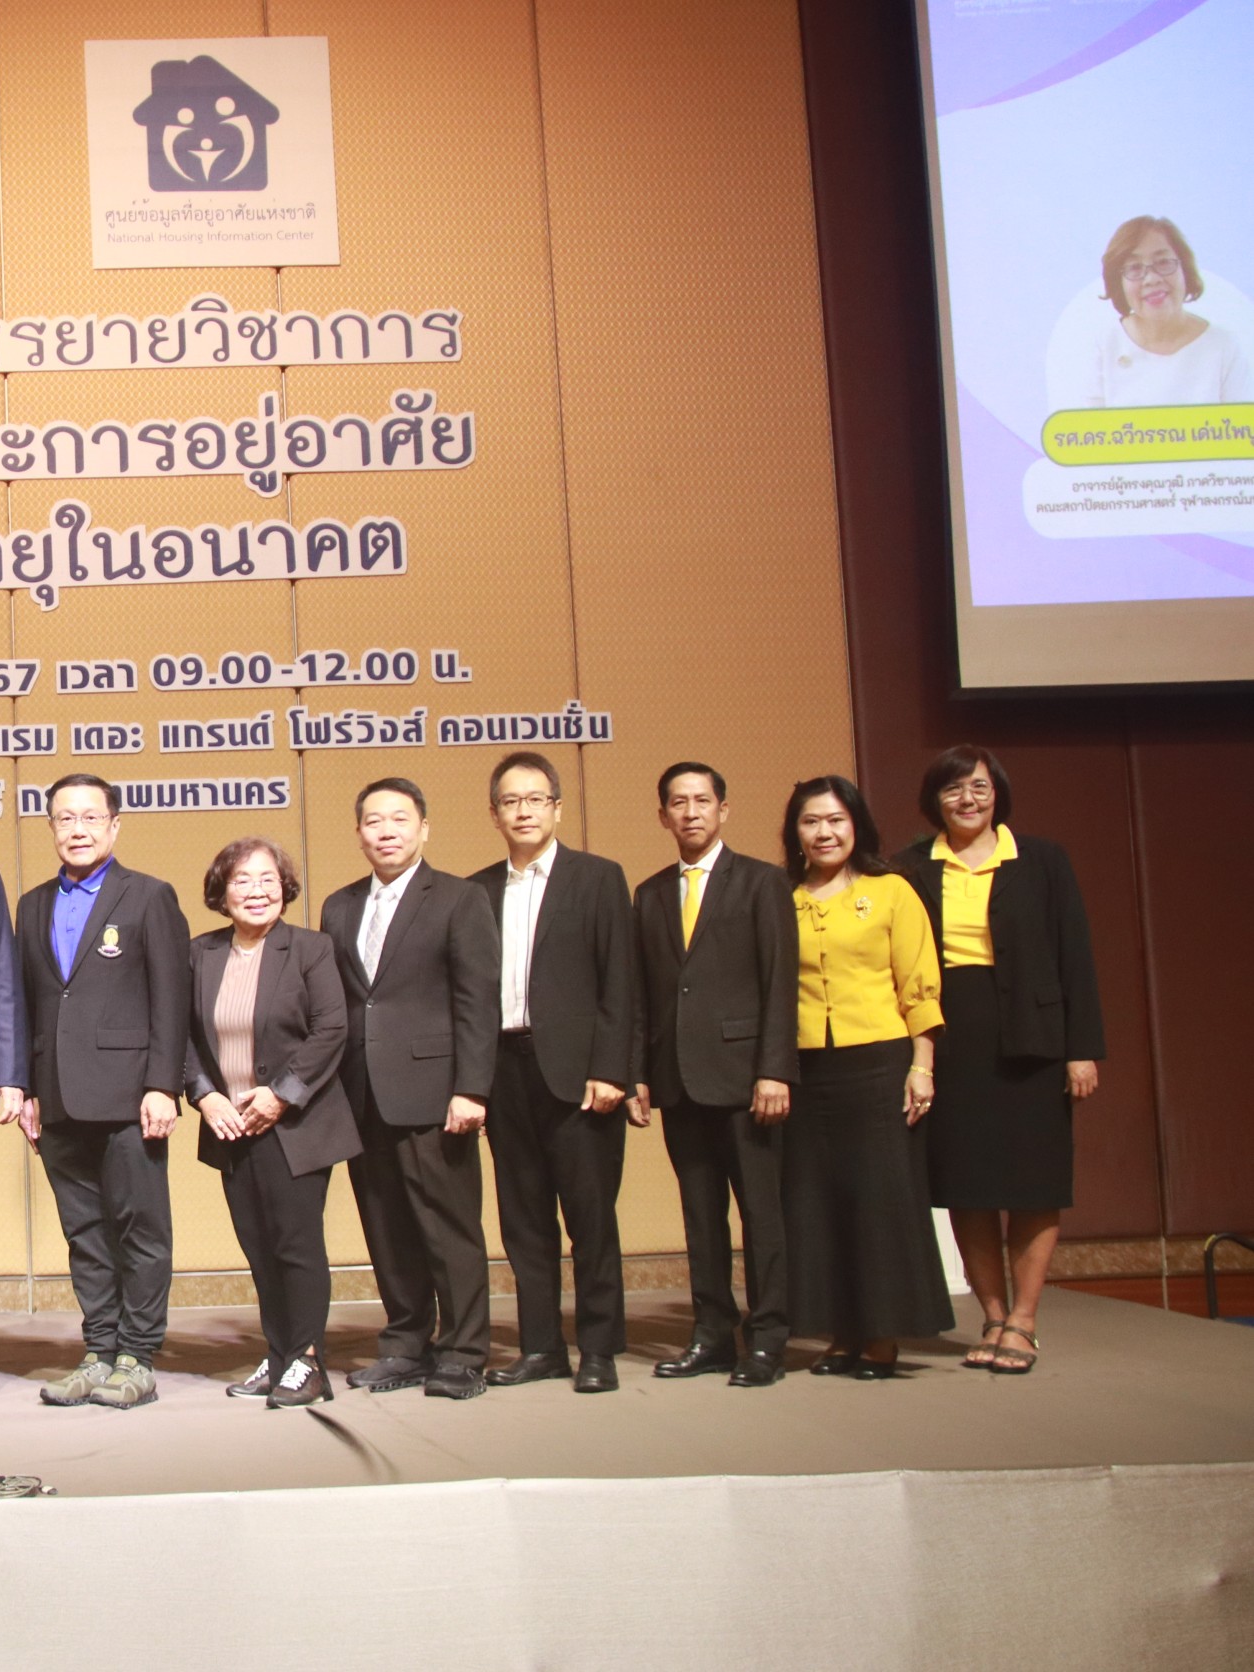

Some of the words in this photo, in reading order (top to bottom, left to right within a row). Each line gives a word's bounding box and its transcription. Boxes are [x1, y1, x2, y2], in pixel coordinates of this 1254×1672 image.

[105, 198, 317, 229] ศูนย์ข้อมูลที่อยู่อาศัยแห่งชาติ
[107, 231, 155, 244] National
[159, 231, 204, 245] Housing
[207, 230, 273, 243] Information
[276, 229, 315, 241] Center
[1054, 422, 1187, 448] รศ.ดร.ฉวีวรรณ
[59, 663, 135, 690] เวลา
[151, 652, 417, 688] 09.00-12.00
[434, 654, 471, 680] น.
[74, 726, 142, 751] เดอะ
[161, 713, 272, 749] แกรนด์
[289, 709, 426, 747] โฟร์วิงส์
[440, 704, 610, 743] คอนเวนชั่น
